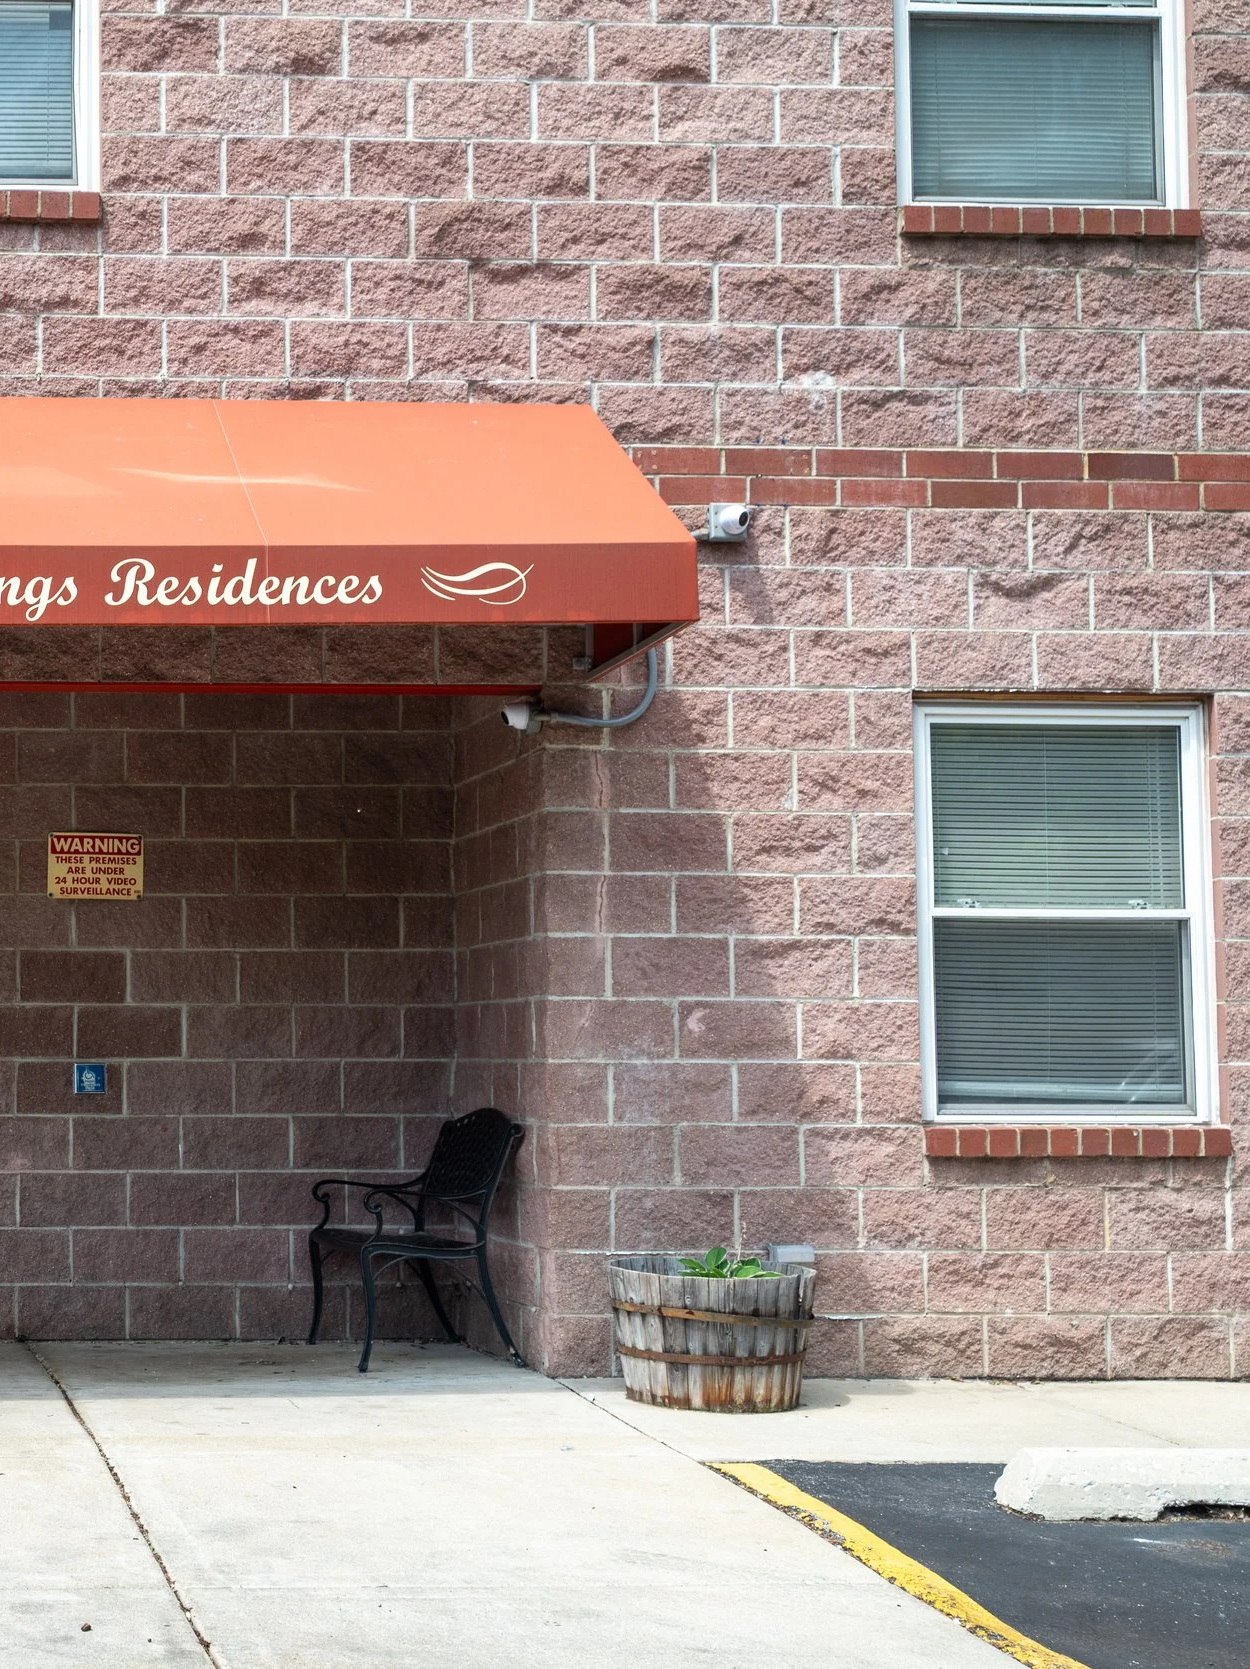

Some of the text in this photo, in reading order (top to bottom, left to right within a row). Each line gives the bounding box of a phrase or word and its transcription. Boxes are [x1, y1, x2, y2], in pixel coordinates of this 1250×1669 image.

[104, 558, 383, 606] Residences
[53, 837, 140, 854] WARNING
[55, 856, 137, 865] THESE PREMISES
[66, 866, 125, 875] ARE UNDER
[55, 876, 137, 886] 24 HOUR VIDEO
[59, 887, 132, 896] SURVEILLANCE
